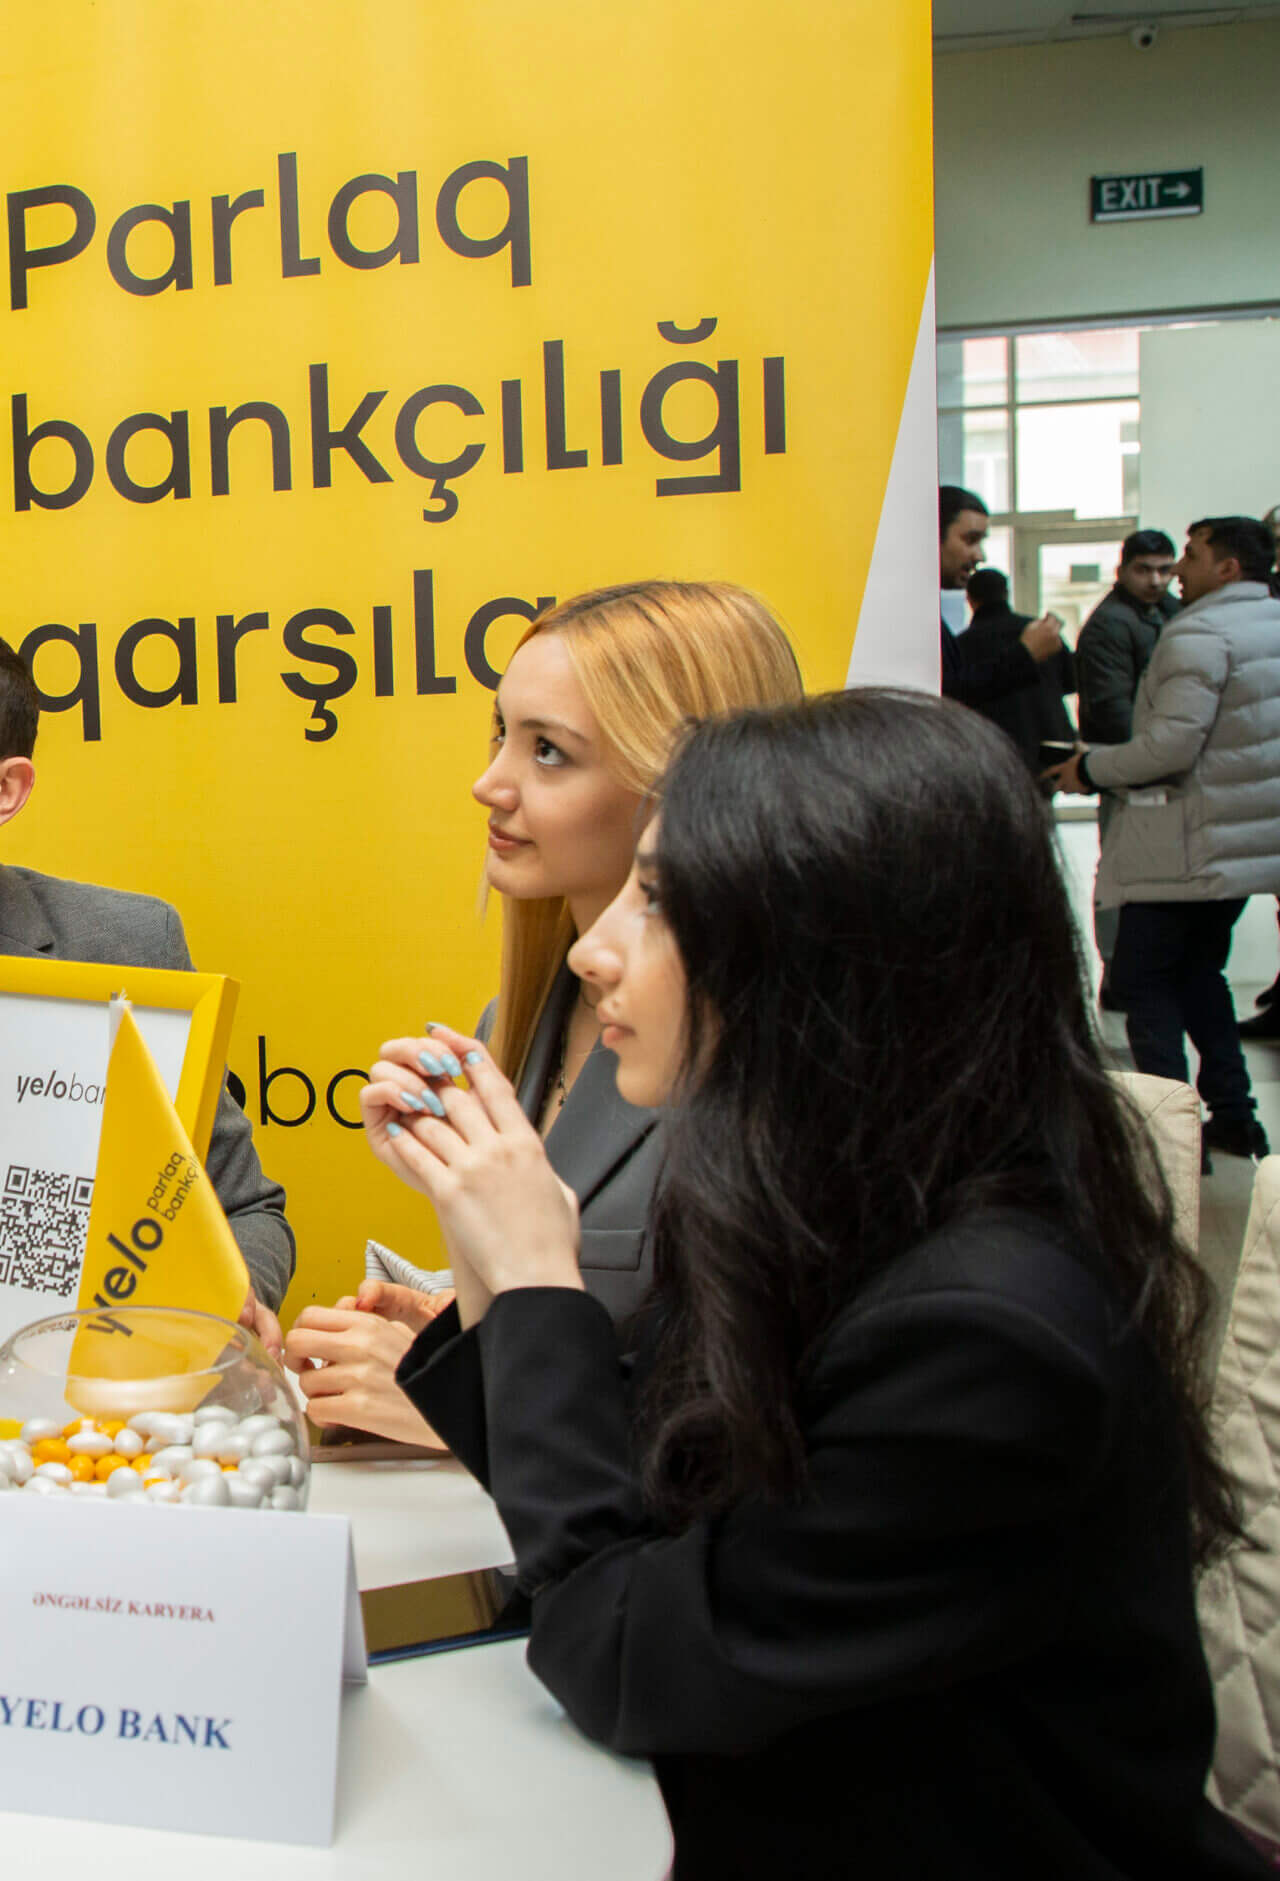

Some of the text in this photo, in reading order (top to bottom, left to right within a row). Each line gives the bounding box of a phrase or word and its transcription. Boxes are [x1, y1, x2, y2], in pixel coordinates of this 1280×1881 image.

[1101, 178, 1162, 211] EXIT
[6, 151, 532, 311] Parlaq
[11, 316, 787, 523] bankçılığı
[146, 1151, 186, 1214] parlaq
[85, 1217, 163, 1338] yelo
[127, 1600, 216, 1624] KARYERA
[117, 1707, 234, 1751] BANK
